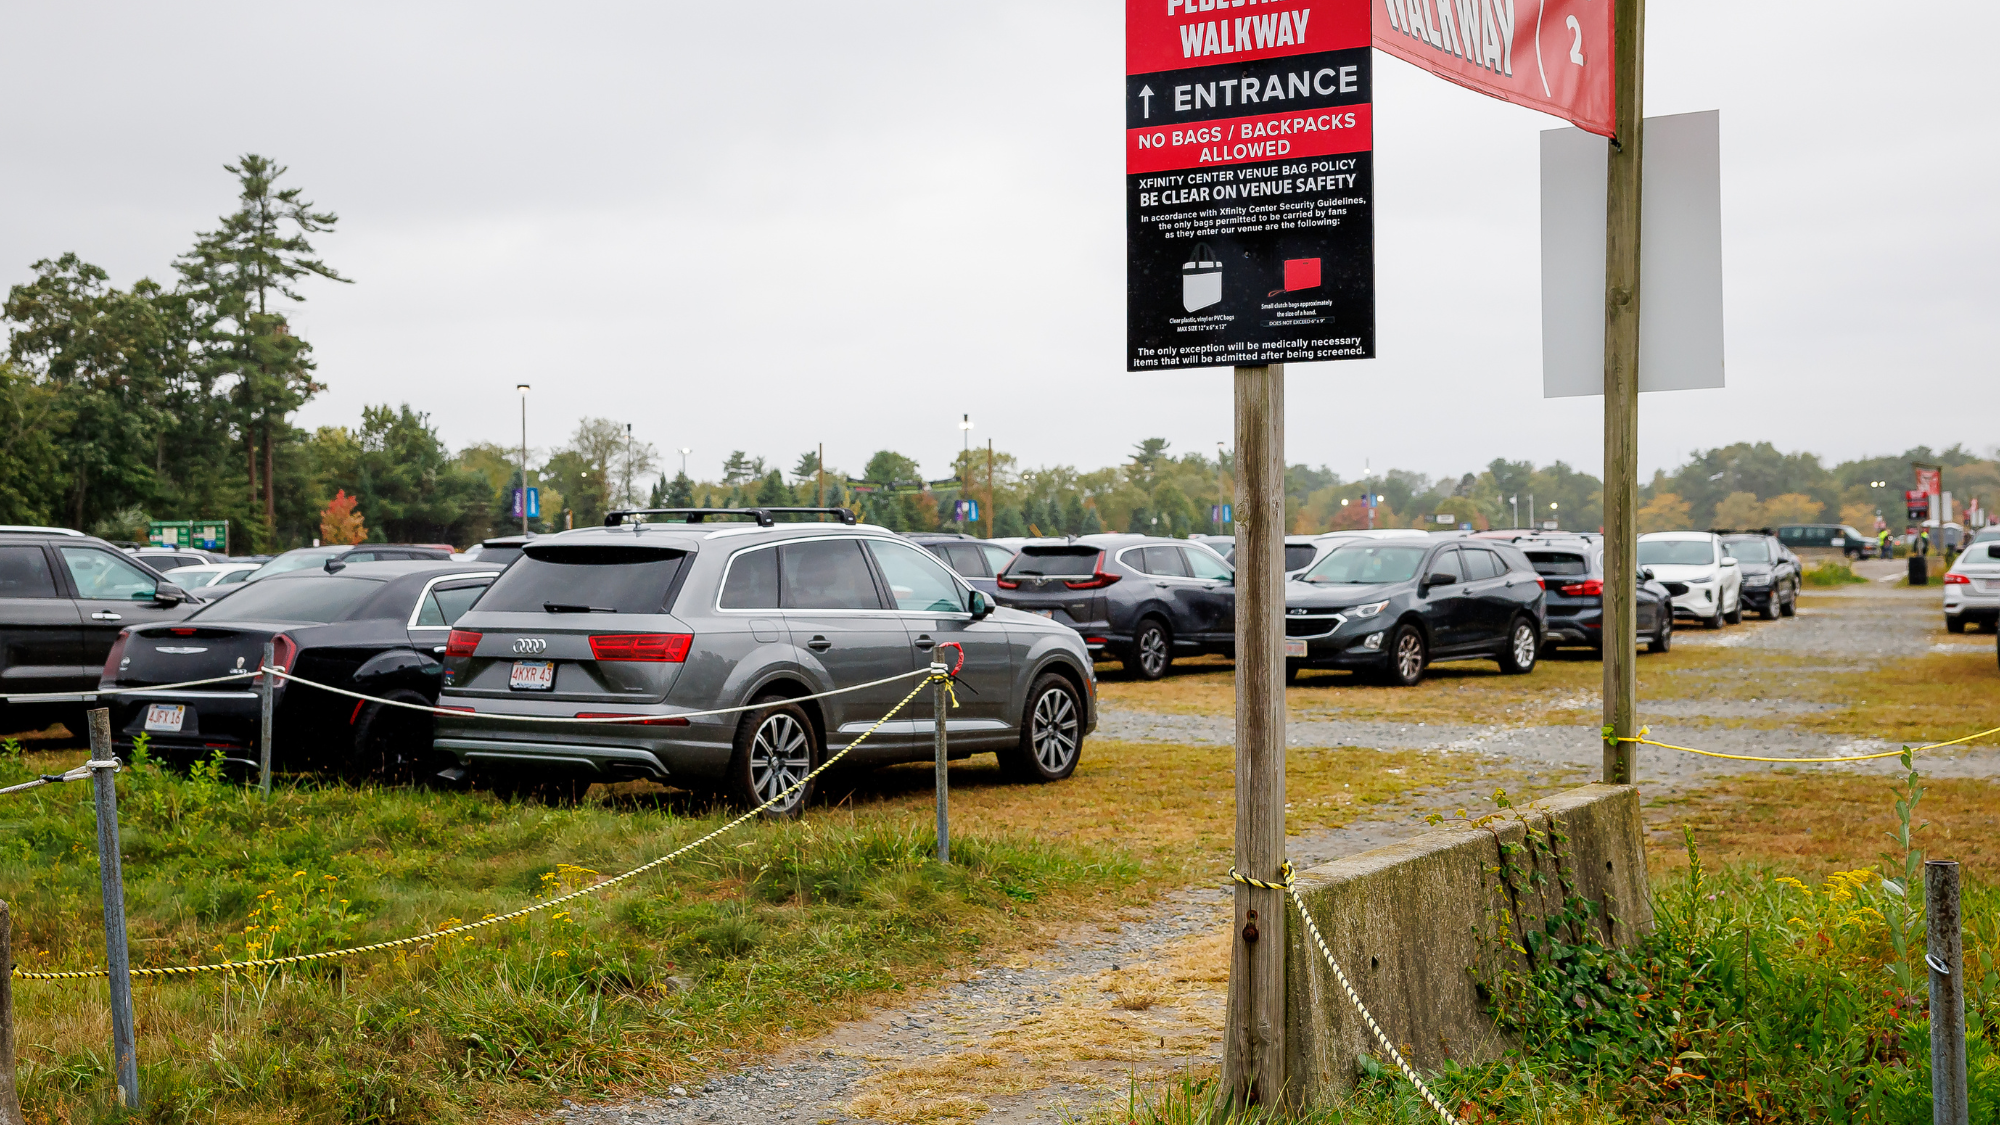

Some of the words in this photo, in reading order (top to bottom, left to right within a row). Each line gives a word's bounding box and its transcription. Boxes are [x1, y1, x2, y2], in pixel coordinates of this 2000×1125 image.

[1180, 9, 1310, 58] WALKWAY
[1566, 15, 1585, 66] 2
[1175, 65, 1357, 111] ENTRANCE
[1139, 133, 1165, 149] NO
[1172, 127, 1221, 146] BAGS
[1228, 125, 1234, 140] /
[1242, 113, 1355, 138] BACKPACKS
[1200, 140, 1290, 162] ALLOWED
[1139, 176, 1184, 189] XFINITY
[1188, 171, 1234, 184] CENTER
[1238, 166, 1278, 179] VENUE
[1282, 164, 1307, 175] BAG
[1312, 159, 1356, 172] POLICY
[1141, 192, 1158, 206] BE
[1162, 188, 1209, 204] CLEAR
[1213, 185, 1236, 199] ON
[1240, 180, 1292, 197] VENUE
[1296, 174, 1356, 192] SAFETY
[1151, 212, 1197, 221] accordance
[1200, 209, 1217, 217] with
[1220, 207, 1246, 215] Xfinity
[1280, 201, 1314, 210] Security
[1317, 198, 1366, 208] Guidelines,
[1174, 221, 1191, 229] only
[1194, 220, 1213, 228] bags
[1216, 215, 1256, 226] permitted
[1283, 210, 1312, 220] carried
[1316, 210, 1326, 218] by
[1177, 229, 1194, 238] they
[1197, 227, 1218, 235] enter
[1298, 218, 1340, 227] following:
[1300, 299, 1332, 308] approximately
[1138, 348, 1154, 356] The
[1158, 346, 1177, 357] only
[1180, 344, 1225, 355] exception
[1228, 343, 1244, 352] will
[1248, 342, 1259, 351] be
[1262, 339, 1308, 351] medically
[1312, 338, 1361, 348] necessary
[1161, 356, 1179, 365] that
[1182, 355, 1198, 364] will
[1202, 354, 1212, 362] be
[1216, 352, 1257, 362] admitted
[1261, 351, 1284, 359] after
[1287, 348, 1314, 359] being
[1317, 346, 1365, 356] screened.
[512, 667, 537, 681] 4KXR
[539, 667, 553, 682] 43
